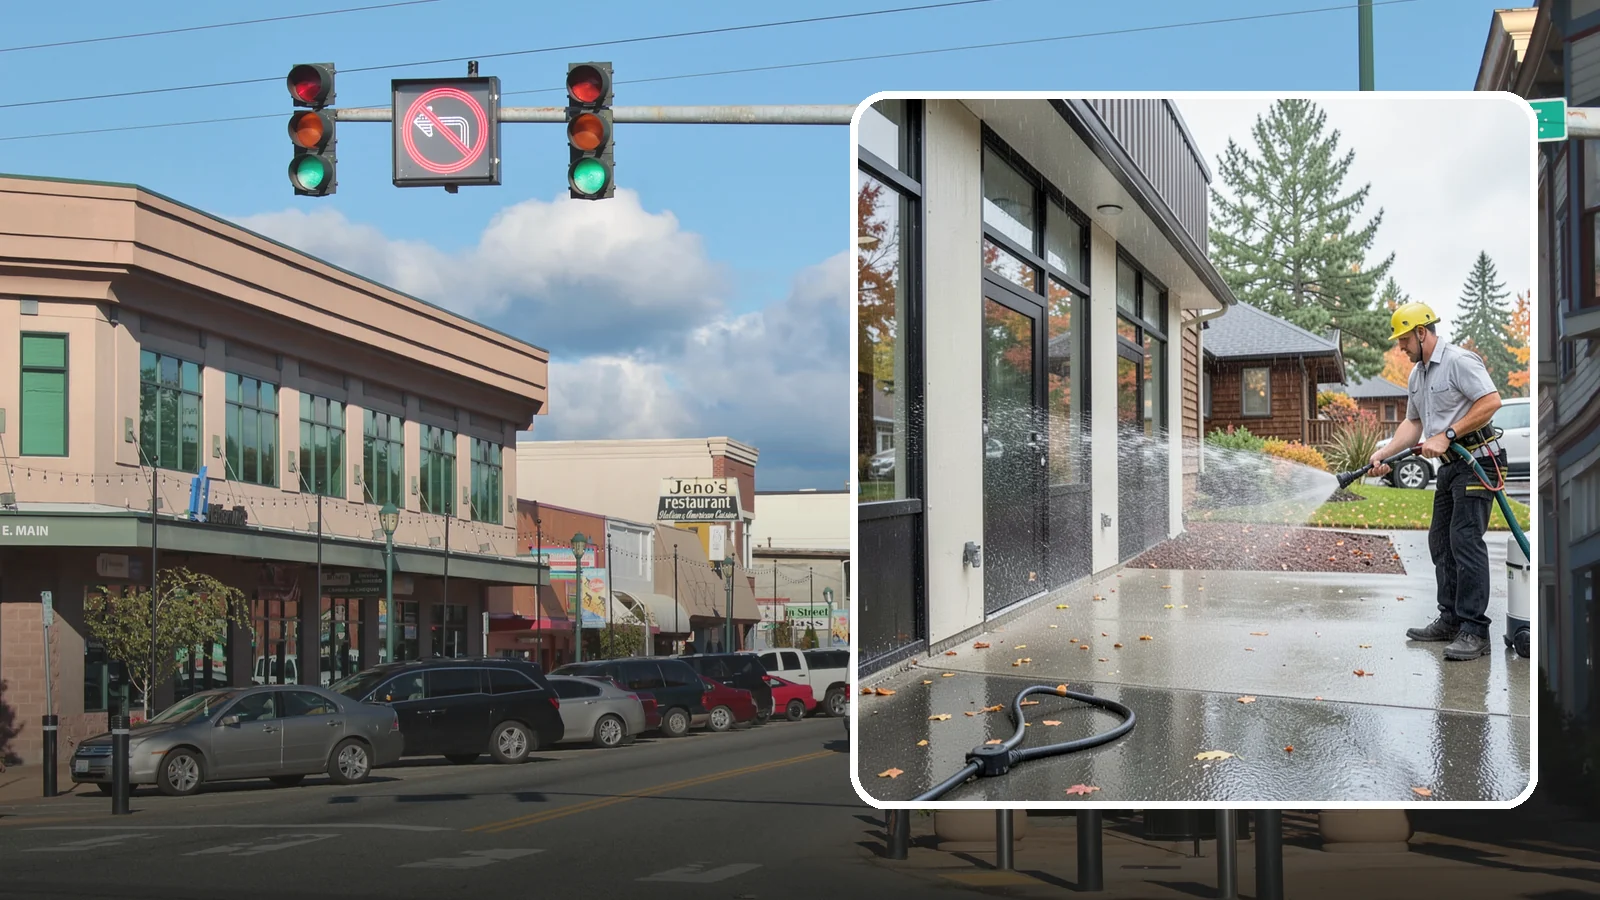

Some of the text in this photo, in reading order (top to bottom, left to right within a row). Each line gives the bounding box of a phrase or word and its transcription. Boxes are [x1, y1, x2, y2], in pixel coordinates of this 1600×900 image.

[670, 480, 727, 494] Jeno's
[665, 497, 730, 508] restaurant
[659, 510, 681, 519] Italian
[686, 509, 714, 519] American
[715, 509, 737, 519] Cuisine
[2, 525, 49, 536] E. MAIN
[797, 607, 828, 616] Street
